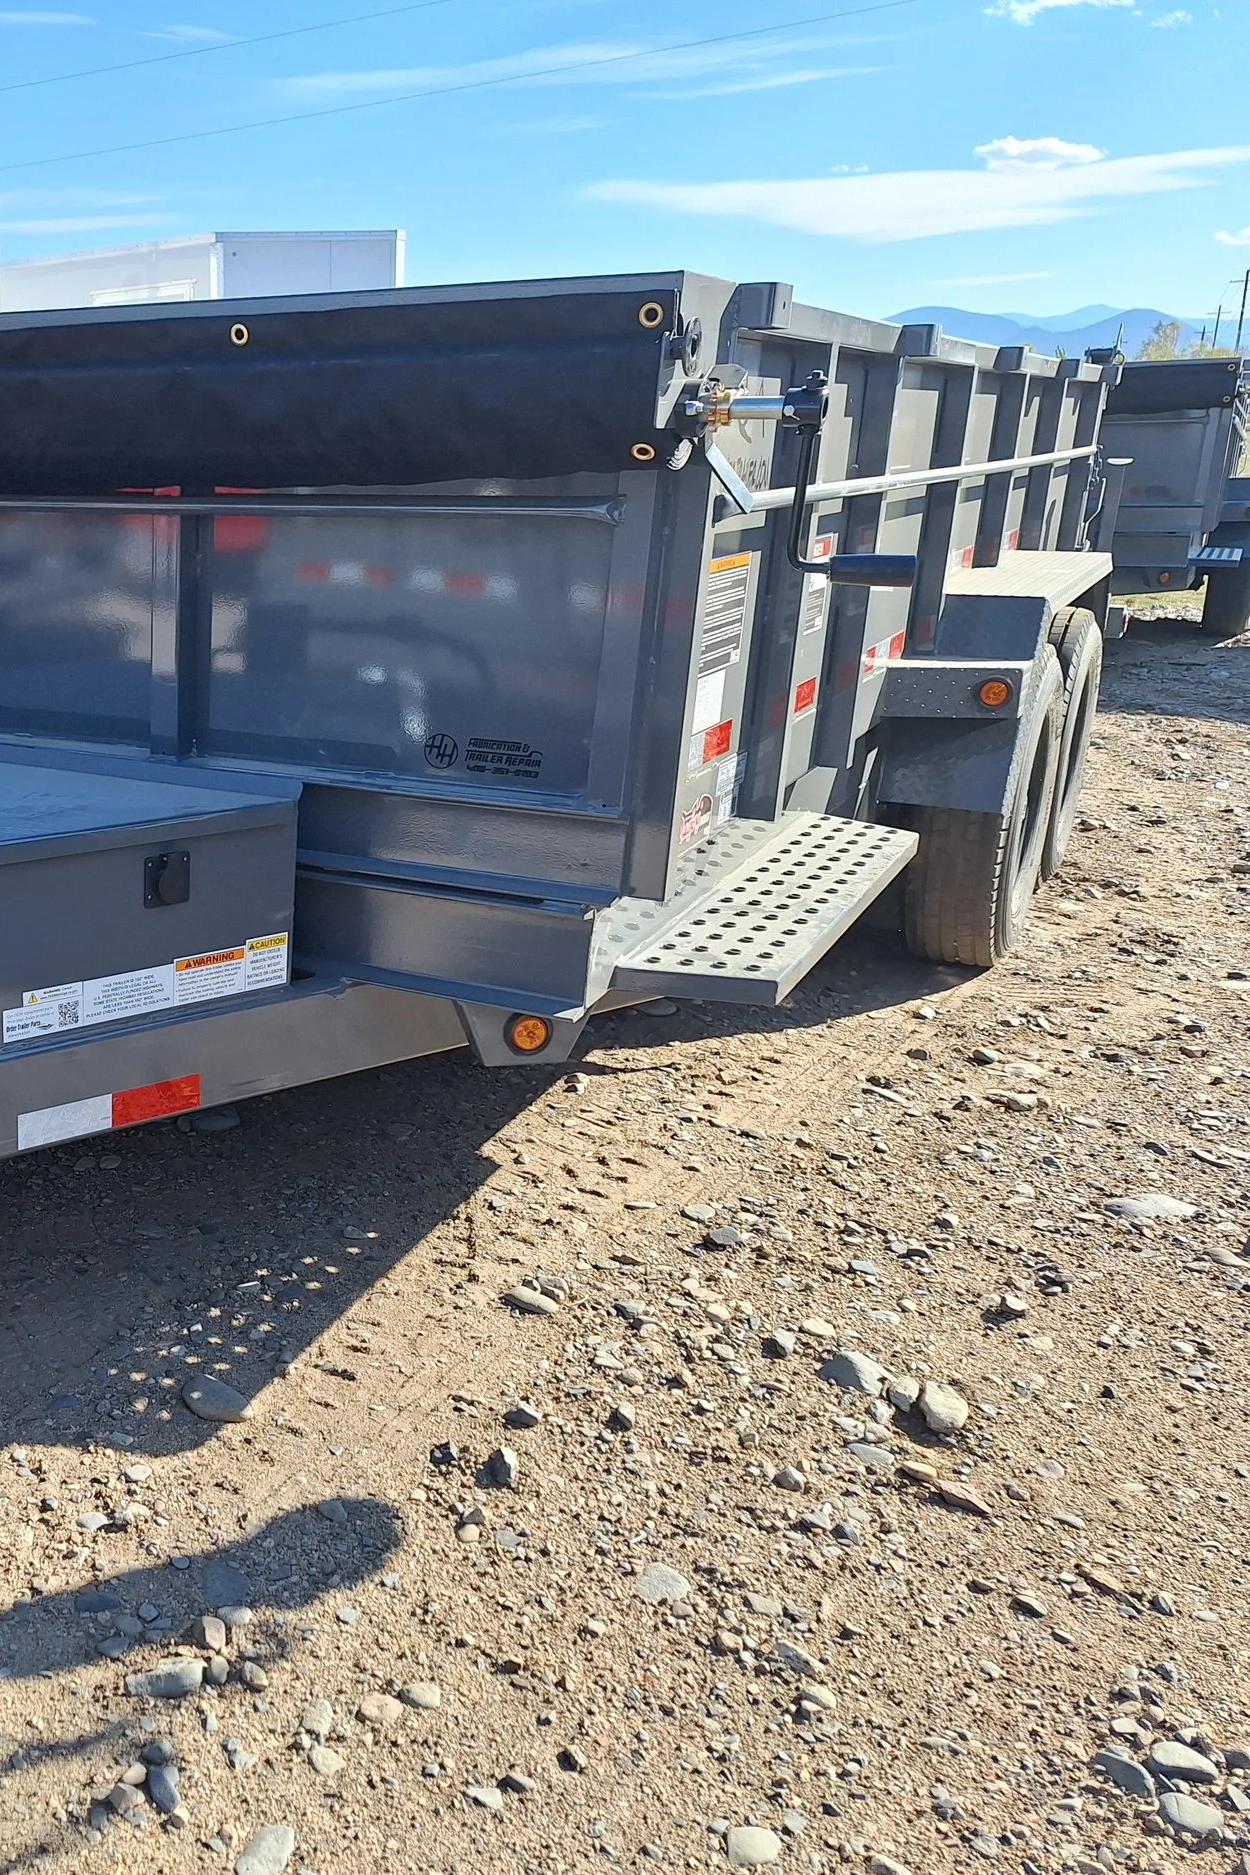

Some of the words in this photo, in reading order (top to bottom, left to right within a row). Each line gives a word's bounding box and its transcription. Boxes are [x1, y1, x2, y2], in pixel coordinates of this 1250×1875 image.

[468, 738, 522, 753] FABRICATION
[464, 750, 505, 764] TRAILER
[504, 756, 542, 768] REPAIR
[255, 937, 286, 948] CAUTION
[193, 952, 234, 966] WARNING
[7, 1025, 17, 1033] Order
[18, 1022, 30, 1030] Trailer
